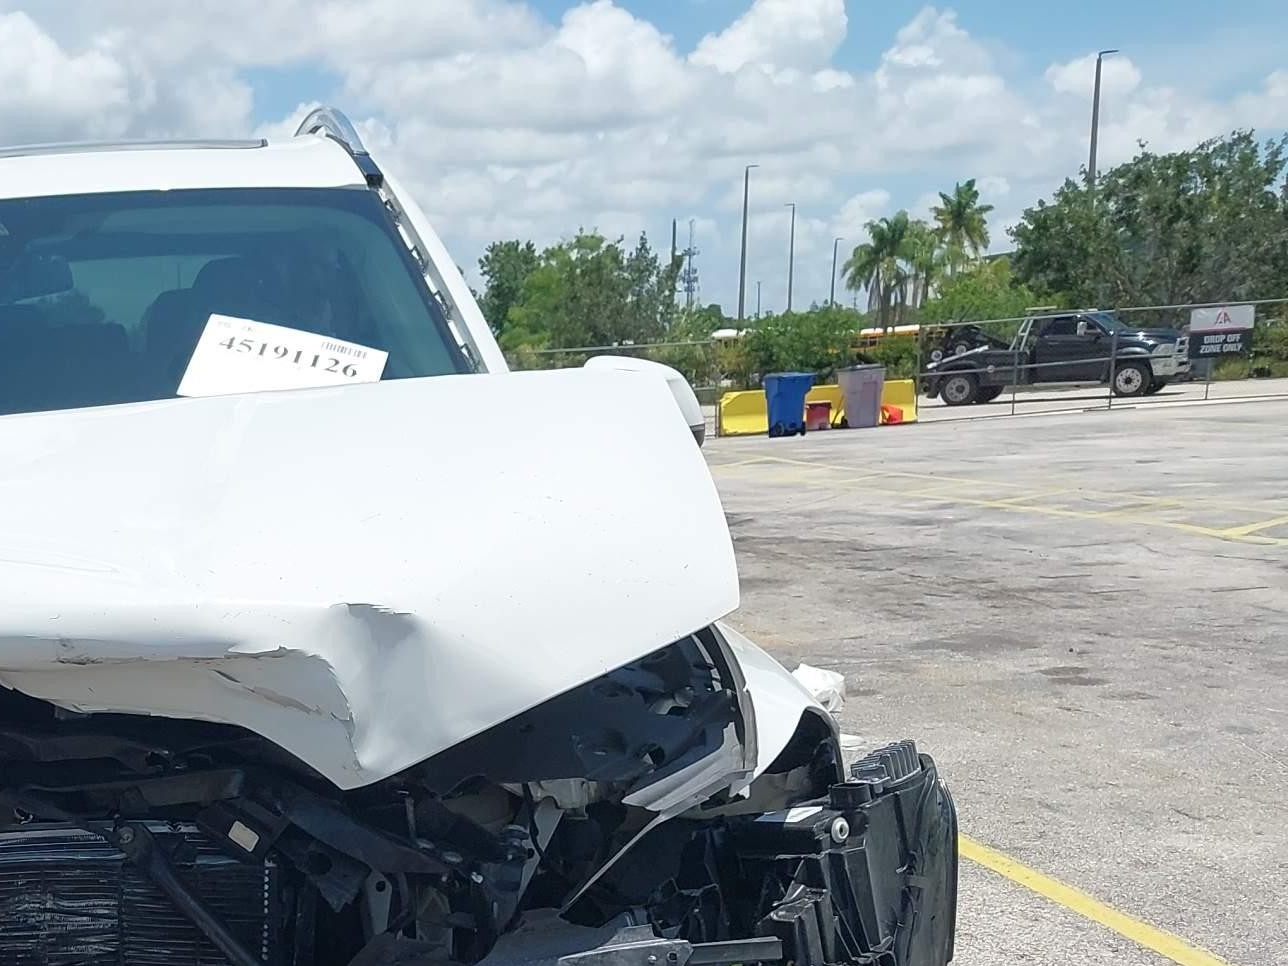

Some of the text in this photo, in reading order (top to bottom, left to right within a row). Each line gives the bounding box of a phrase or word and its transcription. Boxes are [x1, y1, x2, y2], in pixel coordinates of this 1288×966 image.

[1203, 333, 1241, 344] DROP OFF
[1200, 343, 1243, 354] ZONE ONLY
[218, 335, 358, 379] 45191126
